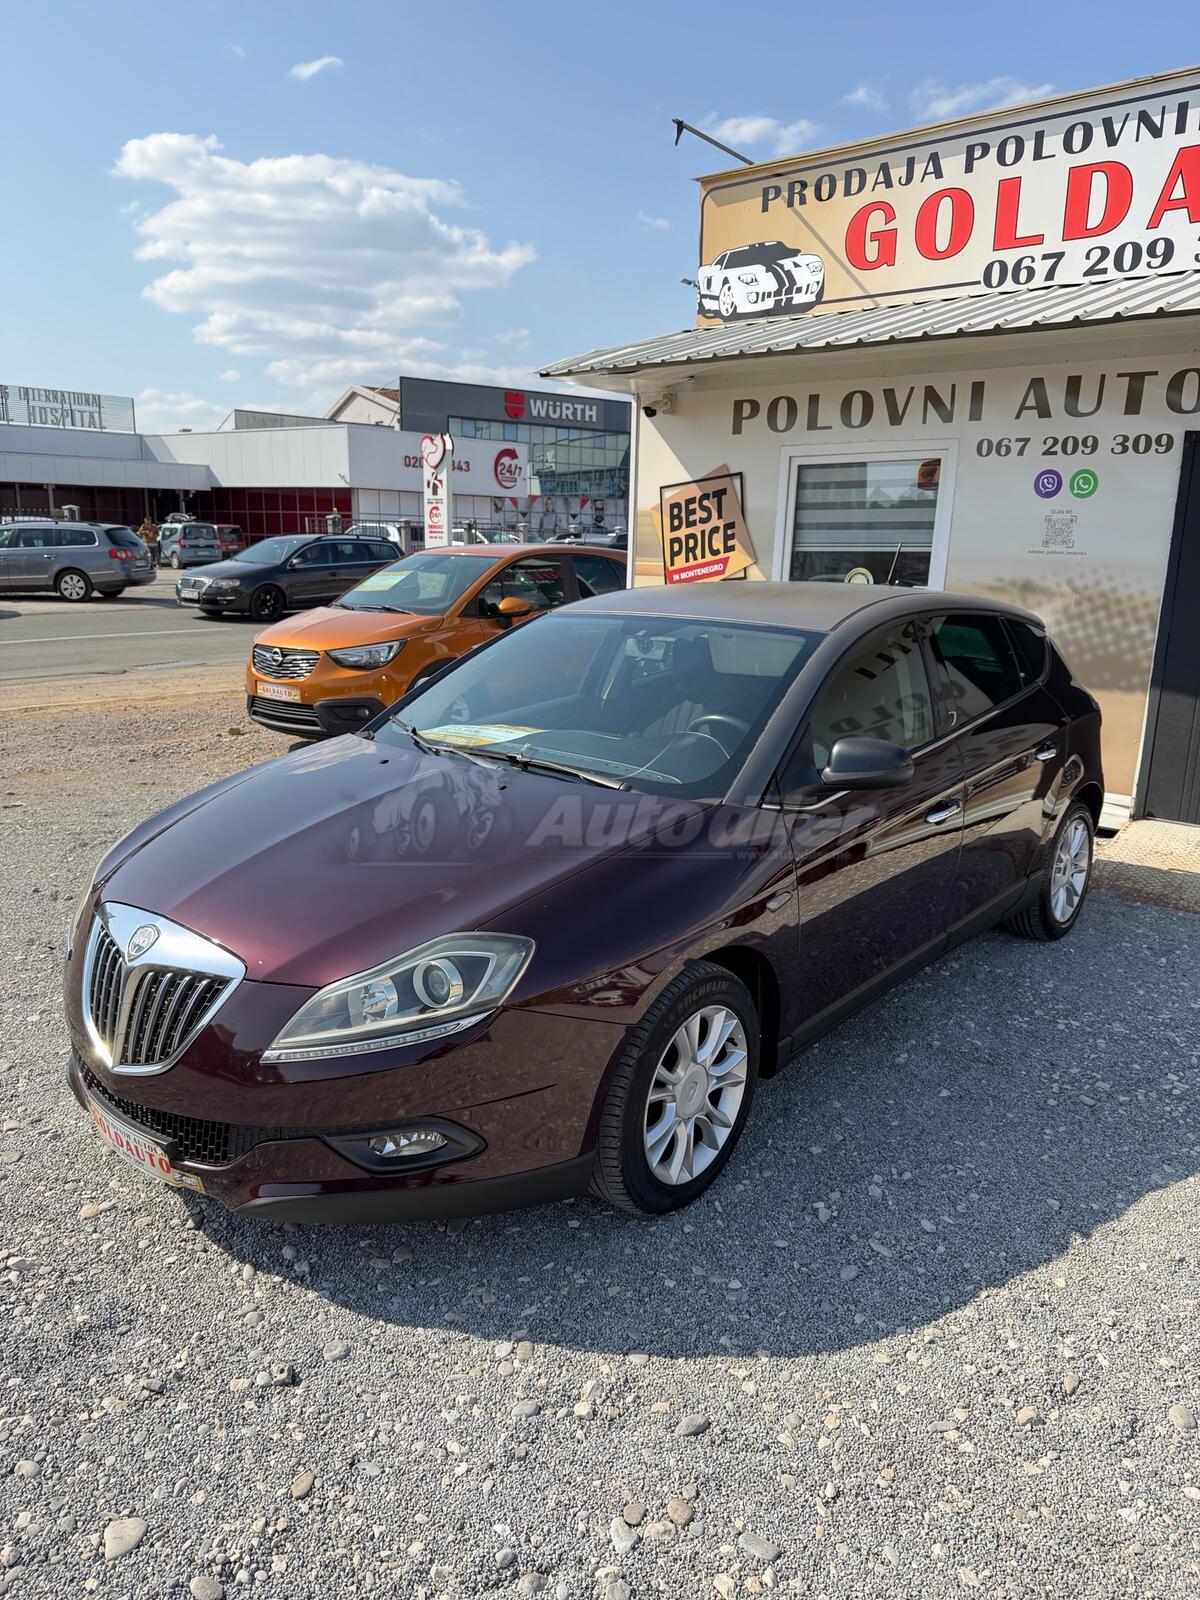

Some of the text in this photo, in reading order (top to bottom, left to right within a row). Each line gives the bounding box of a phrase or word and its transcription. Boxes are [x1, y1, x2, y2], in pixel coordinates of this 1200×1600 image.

[761, 100, 1200, 213] PRODAJA POLOVNI
[982, 251, 1066, 289] 067
[1082, 236, 1175, 277] 209
[28, 404, 106, 430] HOSPITAL
[731, 366, 1200, 435] POLOVNI AUTO
[976, 433, 1175, 458] 067 209 309
[669, 488, 727, 532] BEST
[669, 521, 736, 567] PRICE
[680, 562, 724, 580] MONTENEGRO
